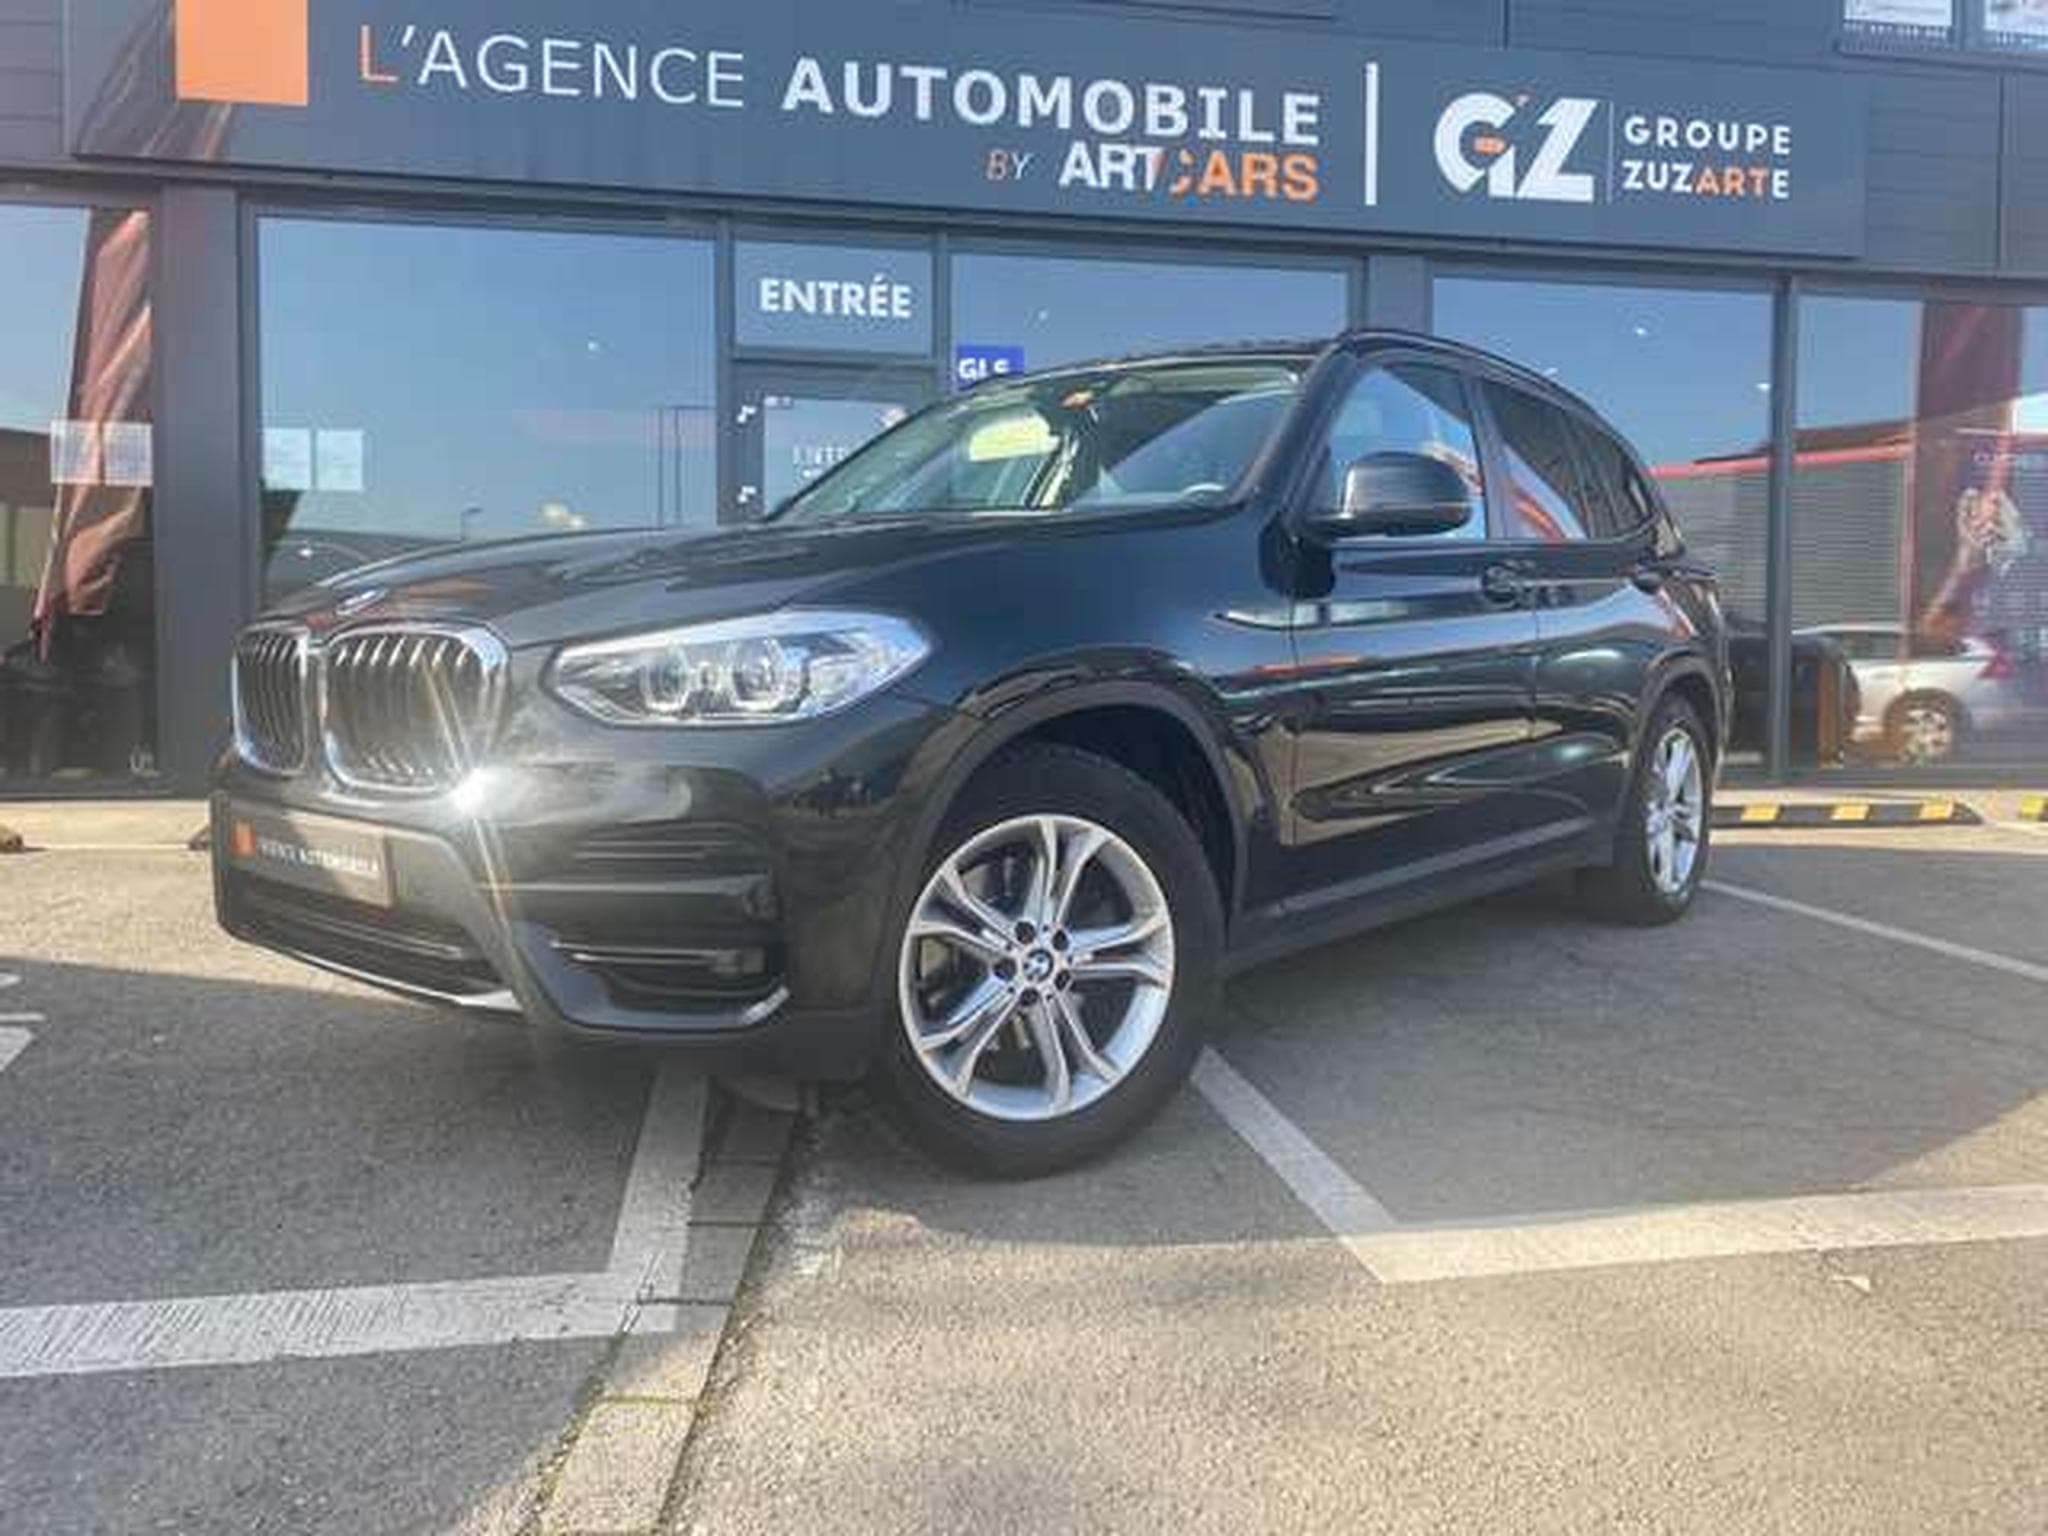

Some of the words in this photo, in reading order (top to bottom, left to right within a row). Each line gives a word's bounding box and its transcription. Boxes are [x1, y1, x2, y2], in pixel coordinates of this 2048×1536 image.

[358, 24, 744, 108] L'AGENCE
[780, 57, 1321, 146] AUTOMOBILE
[1624, 115, 1792, 155] GROUPE
[986, 149, 1033, 180] BY
[1621, 159, 1790, 199] ZUZARTE
[758, 273, 913, 318] ENTRÉE
